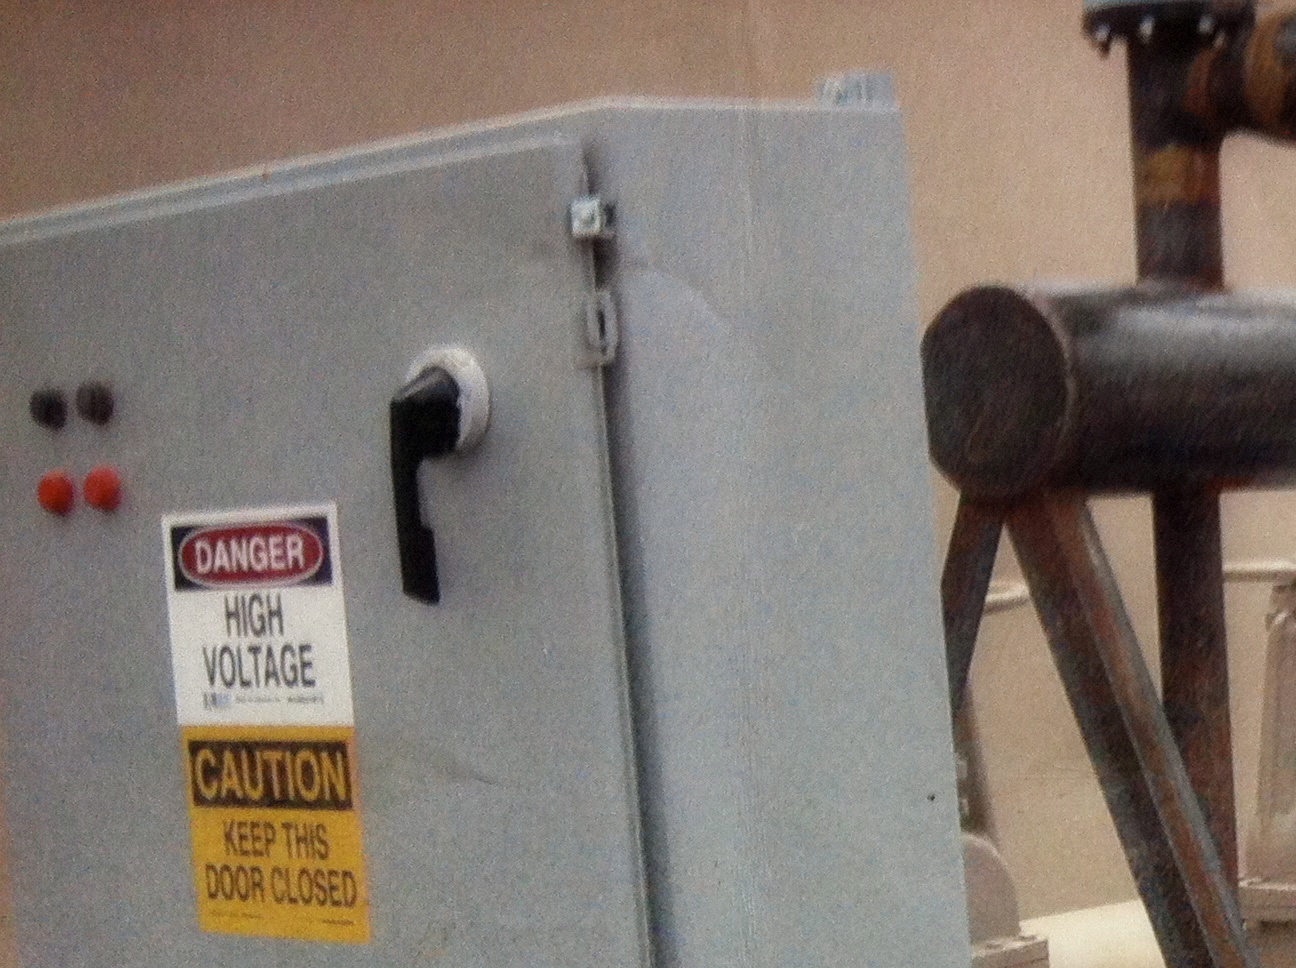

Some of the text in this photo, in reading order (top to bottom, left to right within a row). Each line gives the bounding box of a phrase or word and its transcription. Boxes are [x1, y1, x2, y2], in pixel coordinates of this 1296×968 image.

[194, 533, 305, 575] DANGER
[223, 592, 285, 638] HIGH
[202, 643, 316, 689] VOLTAGE
[195, 749, 347, 801] CAUTION
[223, 819, 330, 861] KEEP THIS
[205, 863, 357, 908] DOOR CLOSED
